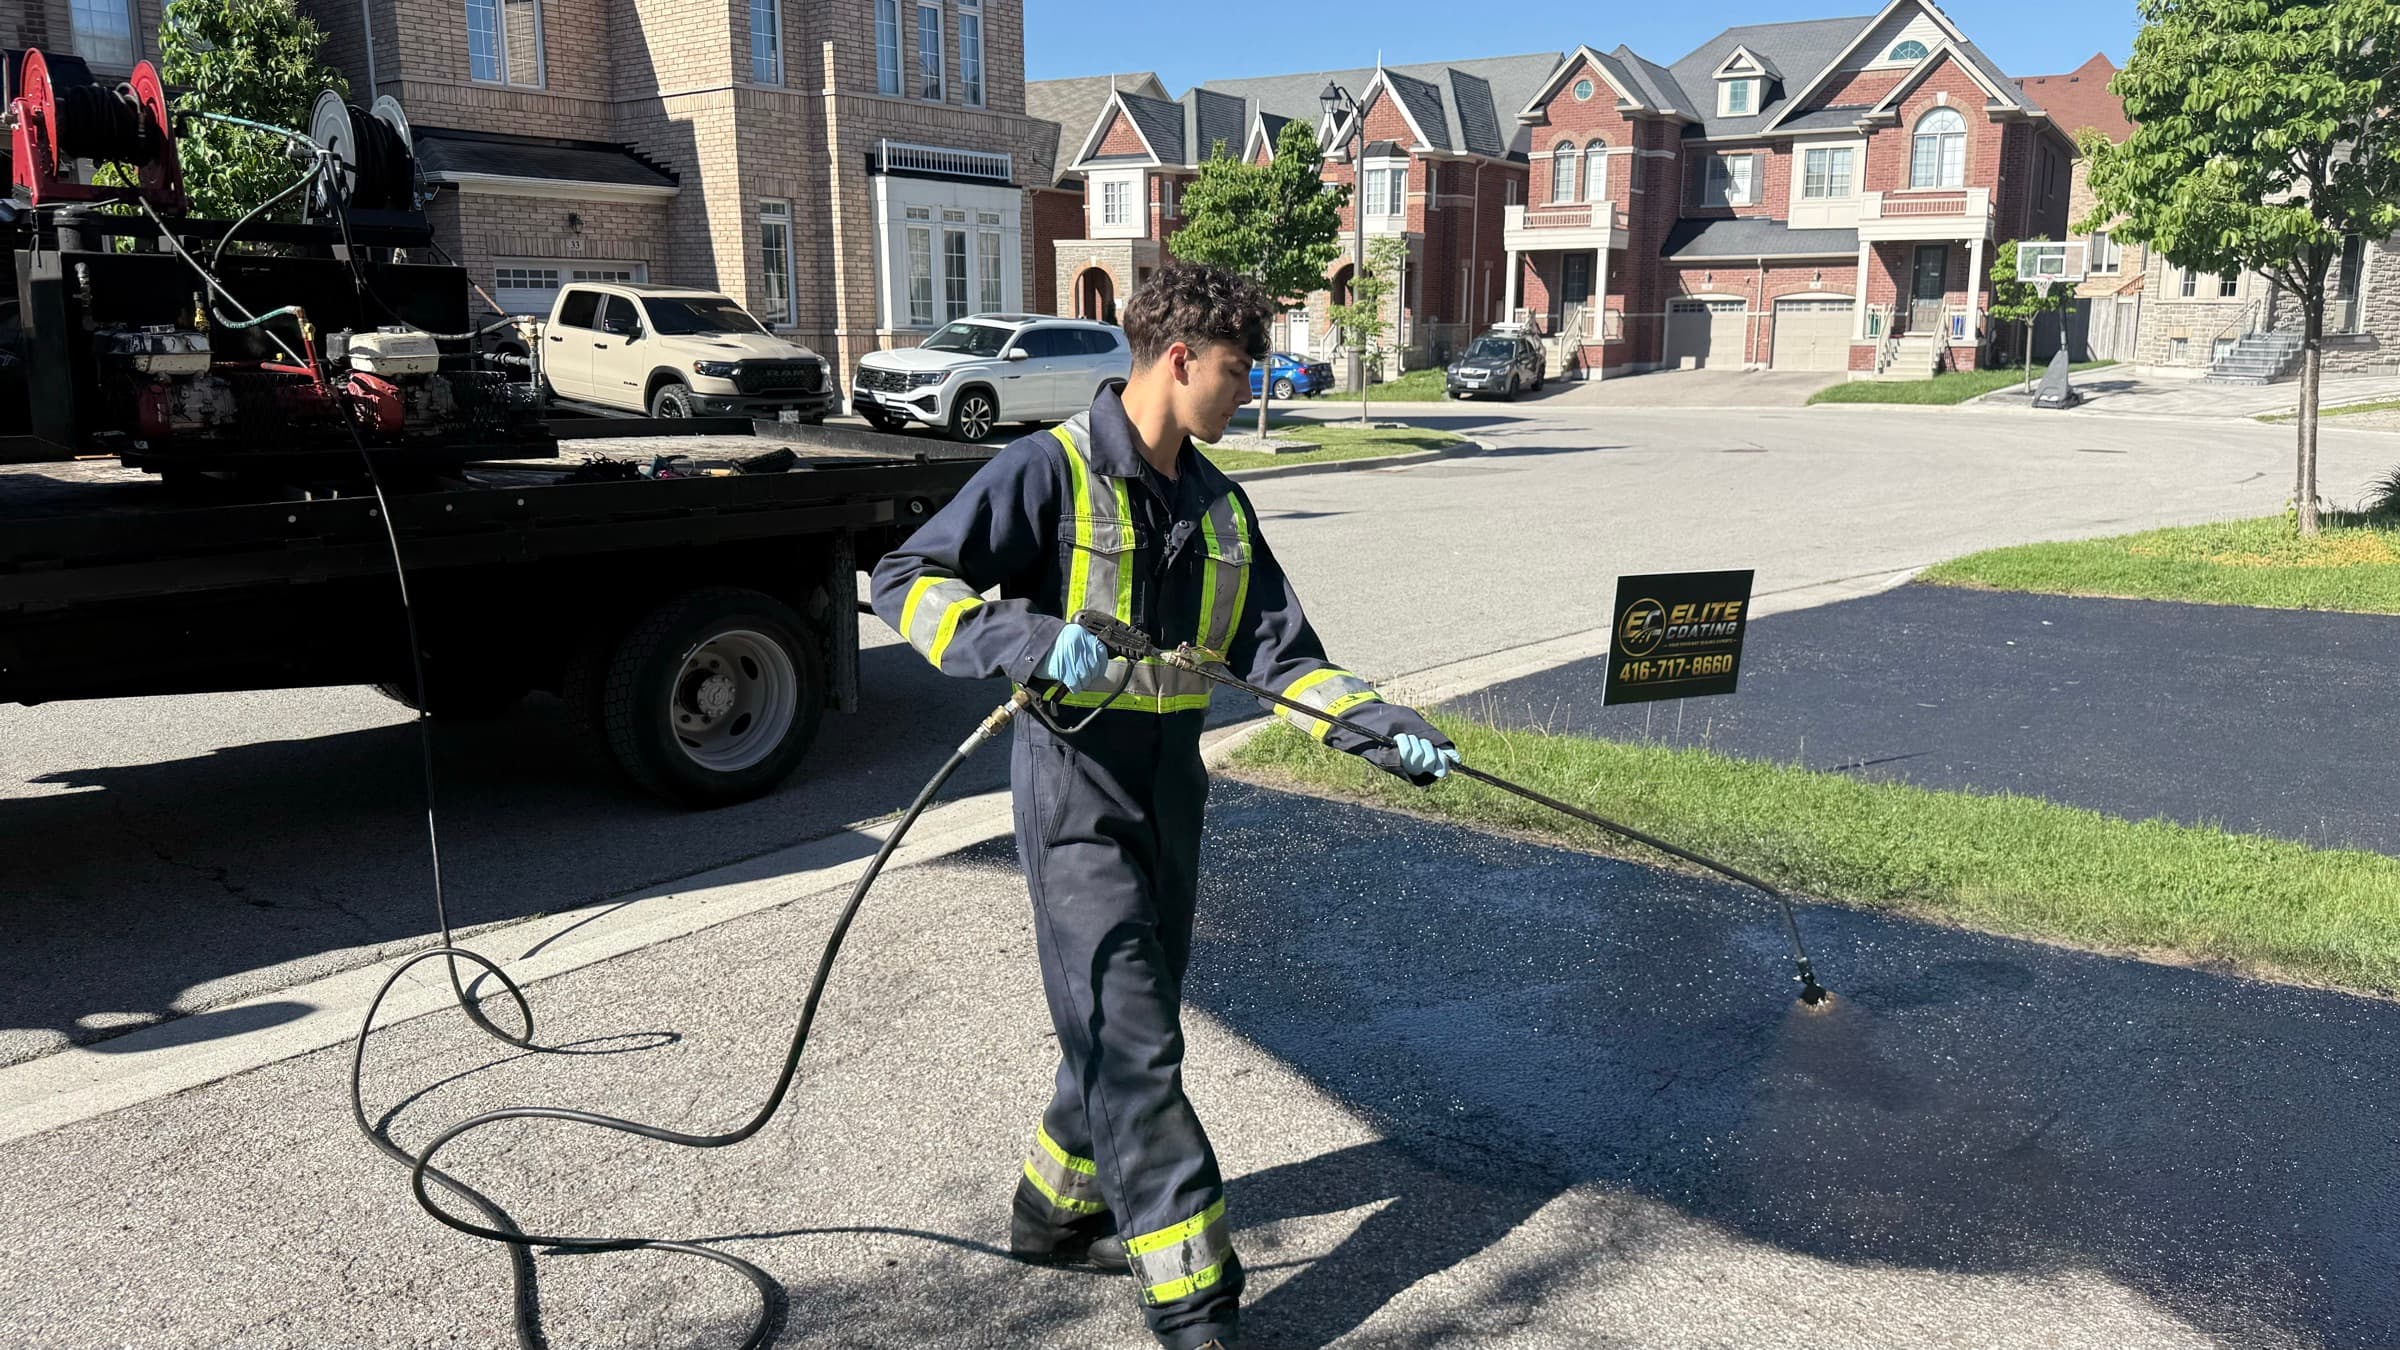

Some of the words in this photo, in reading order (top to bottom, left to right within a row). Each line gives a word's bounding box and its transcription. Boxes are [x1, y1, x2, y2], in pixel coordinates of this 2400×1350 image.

[766, 369, 804, 377] RAM
[1669, 601, 1742, 624] ELITE
[1666, 622, 1737, 639] COATING
[1619, 655, 1732, 681] 416-717-8660
